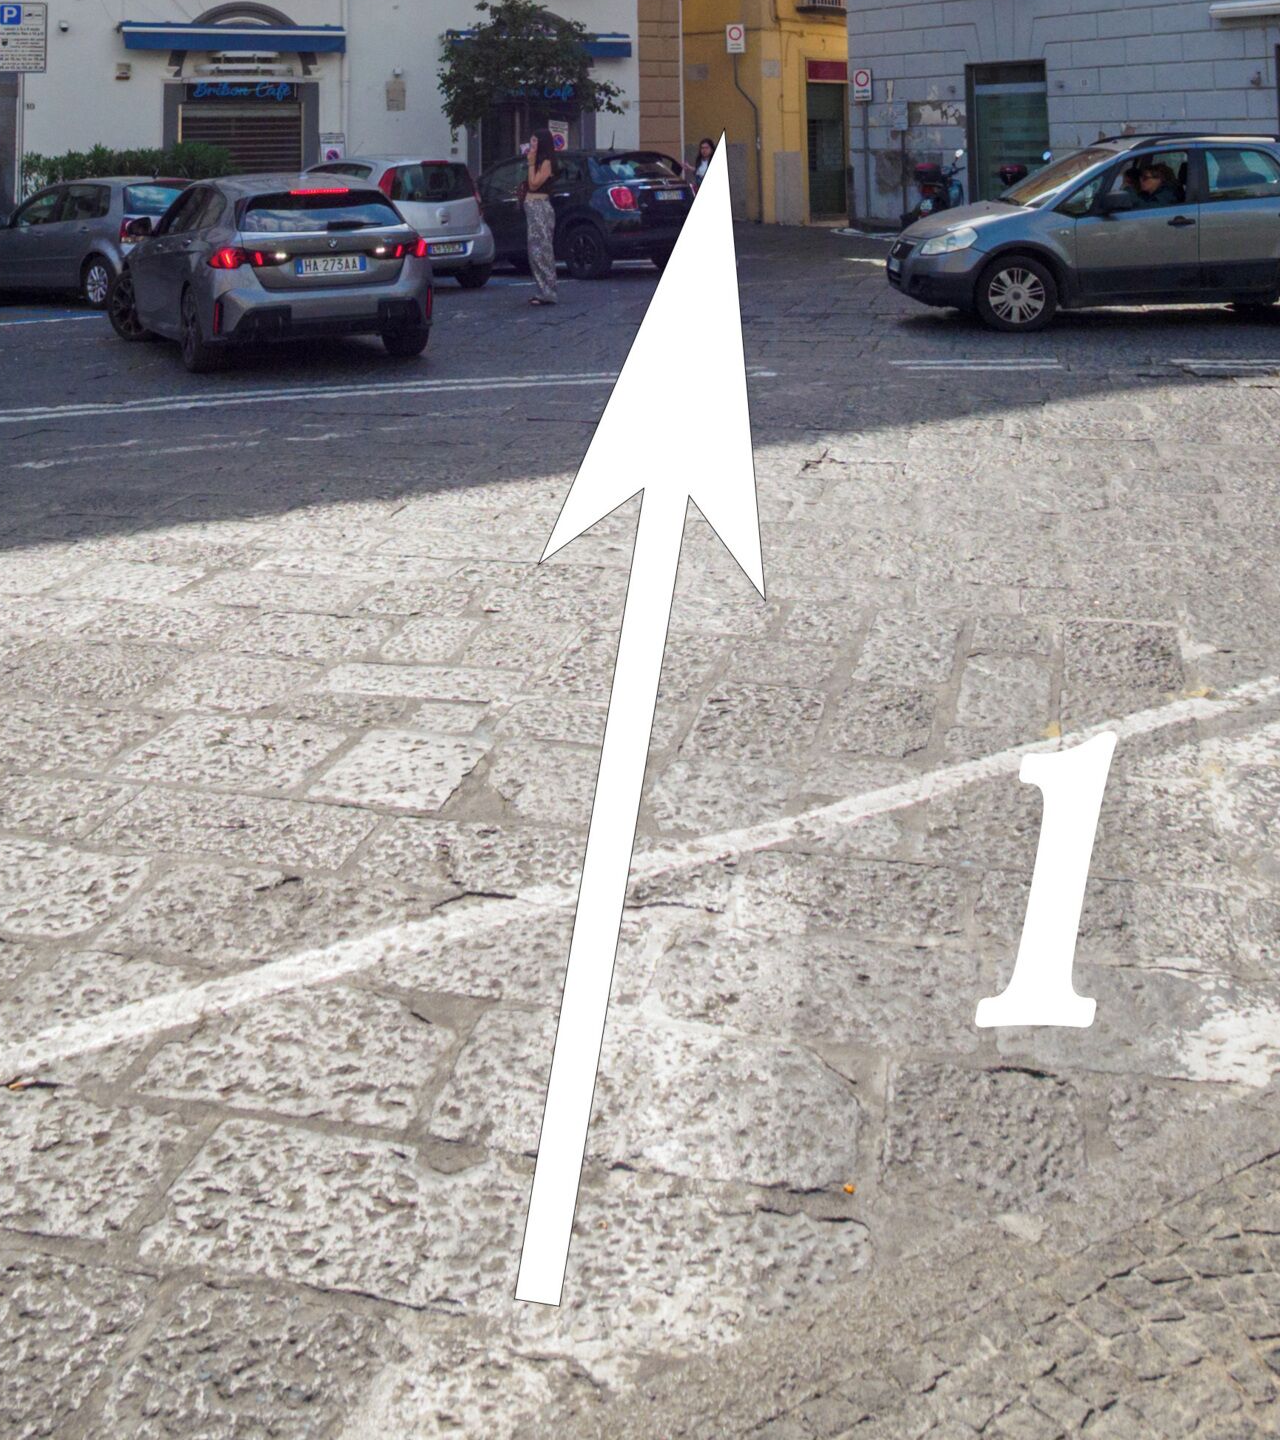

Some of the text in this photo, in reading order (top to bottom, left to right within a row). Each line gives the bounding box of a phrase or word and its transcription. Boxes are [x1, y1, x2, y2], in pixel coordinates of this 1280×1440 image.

[3, 6, 17, 24] P
[304, 257, 359, 273] HA 273AA
